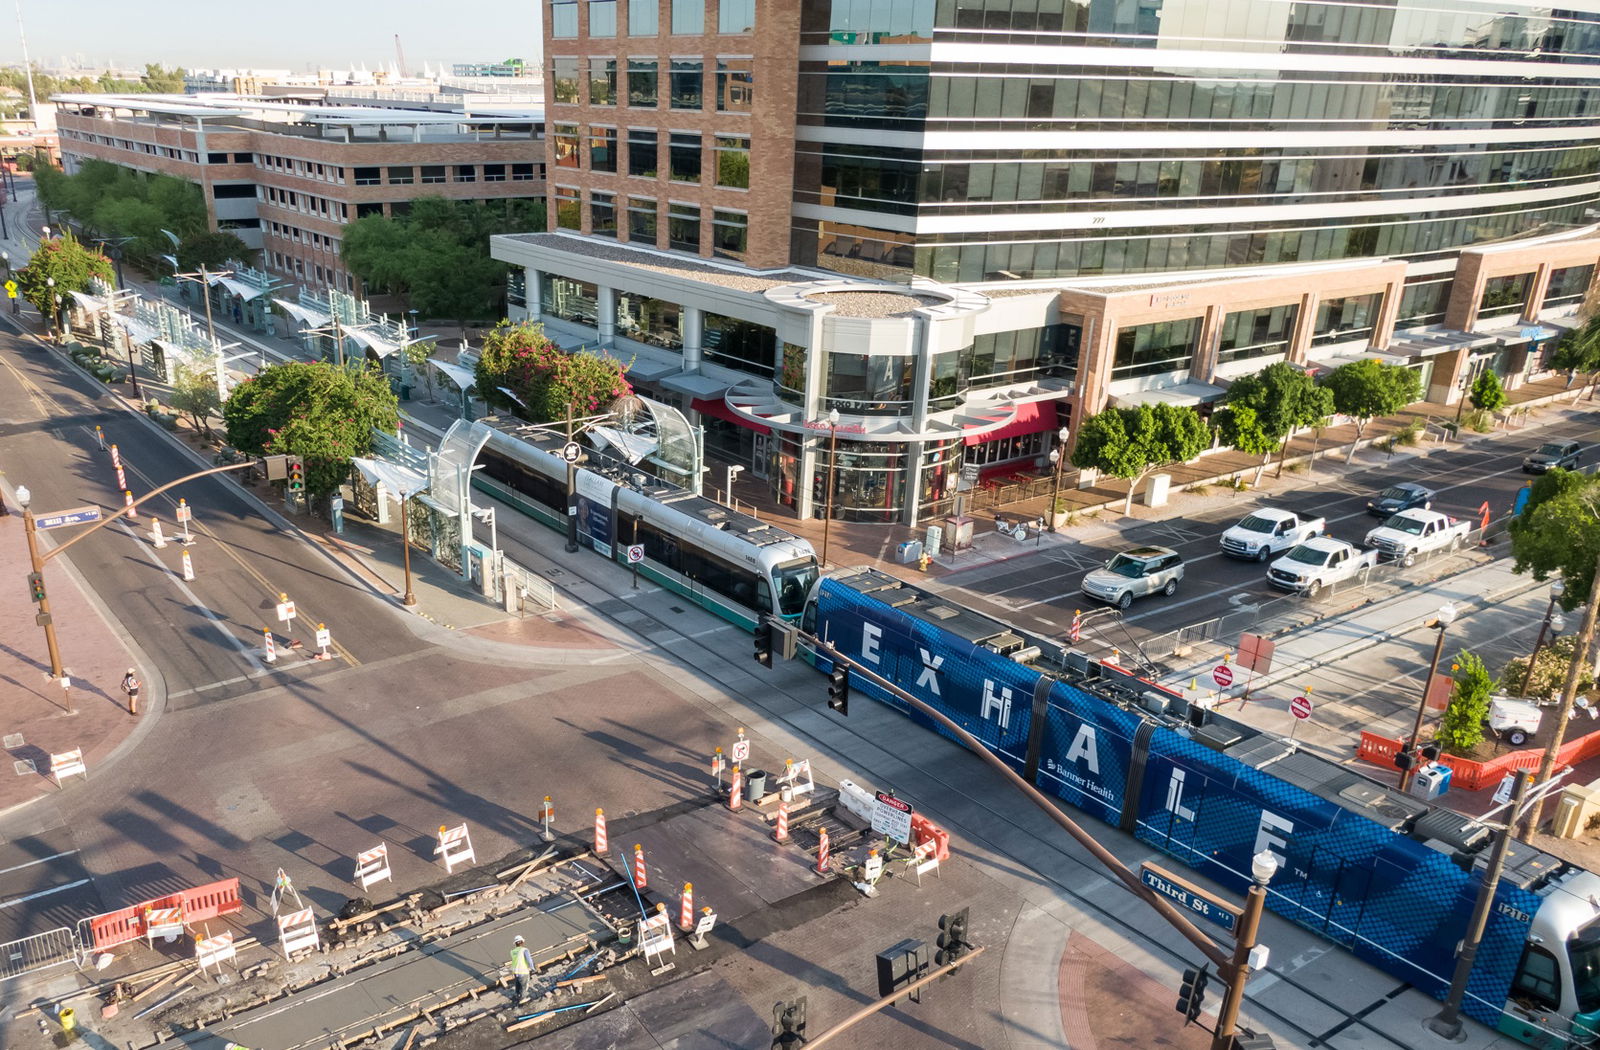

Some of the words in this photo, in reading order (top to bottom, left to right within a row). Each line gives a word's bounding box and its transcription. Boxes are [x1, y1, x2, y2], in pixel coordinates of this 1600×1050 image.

[1056, 764, 1086, 786] Banner
[1086, 779, 1115, 801] Health
[882, 795, 905, 809] DANGER
[1148, 874, 1187, 903] Third
[1192, 898, 1209, 914] St
[1500, 903, 1529, 922] 121B
